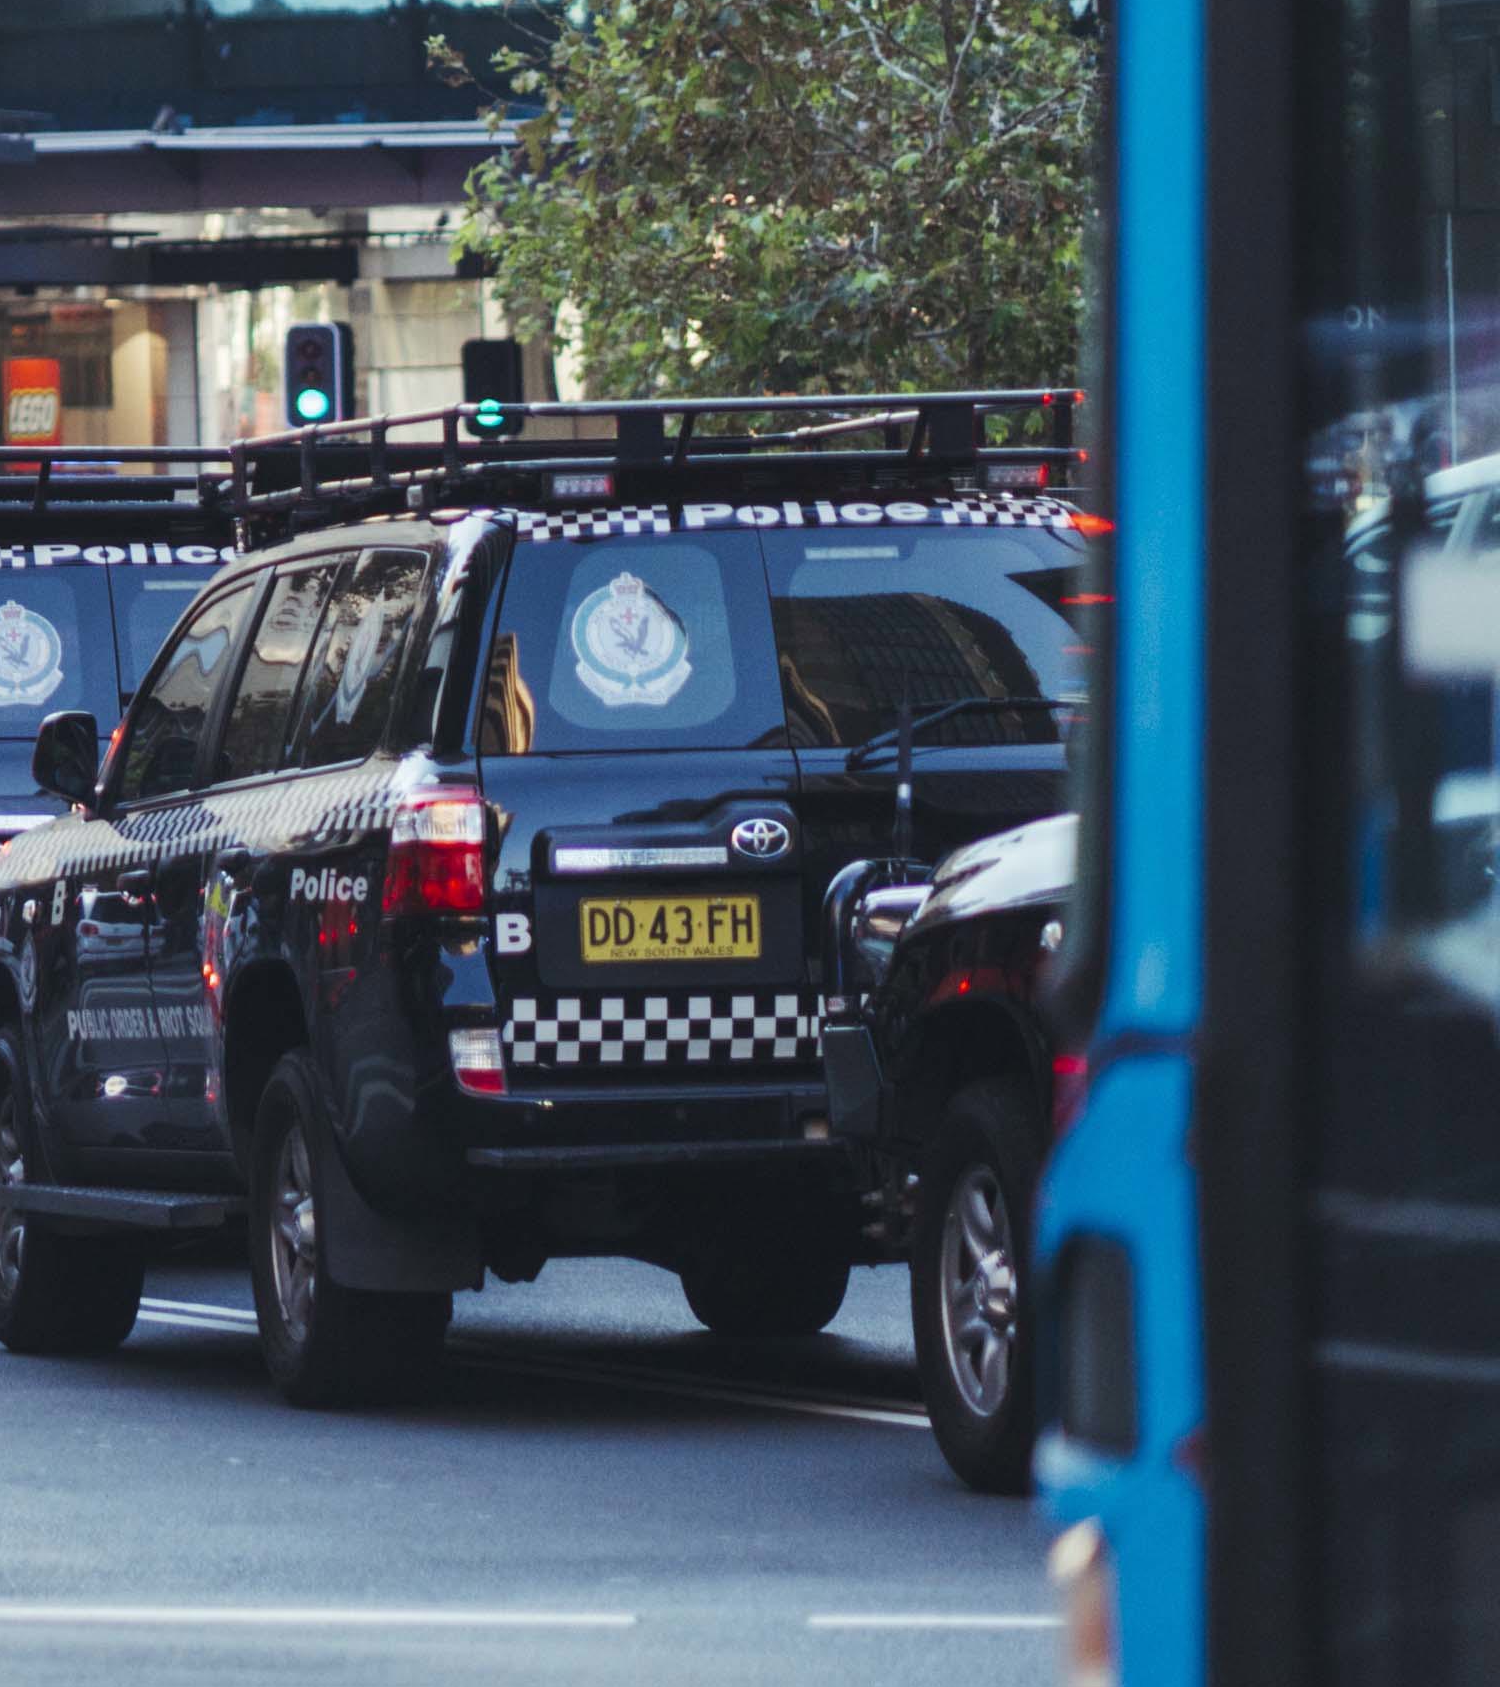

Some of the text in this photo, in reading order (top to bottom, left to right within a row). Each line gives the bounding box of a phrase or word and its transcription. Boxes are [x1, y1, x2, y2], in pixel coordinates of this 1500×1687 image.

[681, 499, 931, 529] Police
[289, 867, 369, 902] Police
[495, 913, 532, 954] B
[610, 945, 735, 959] NEW SOUTH WALES
